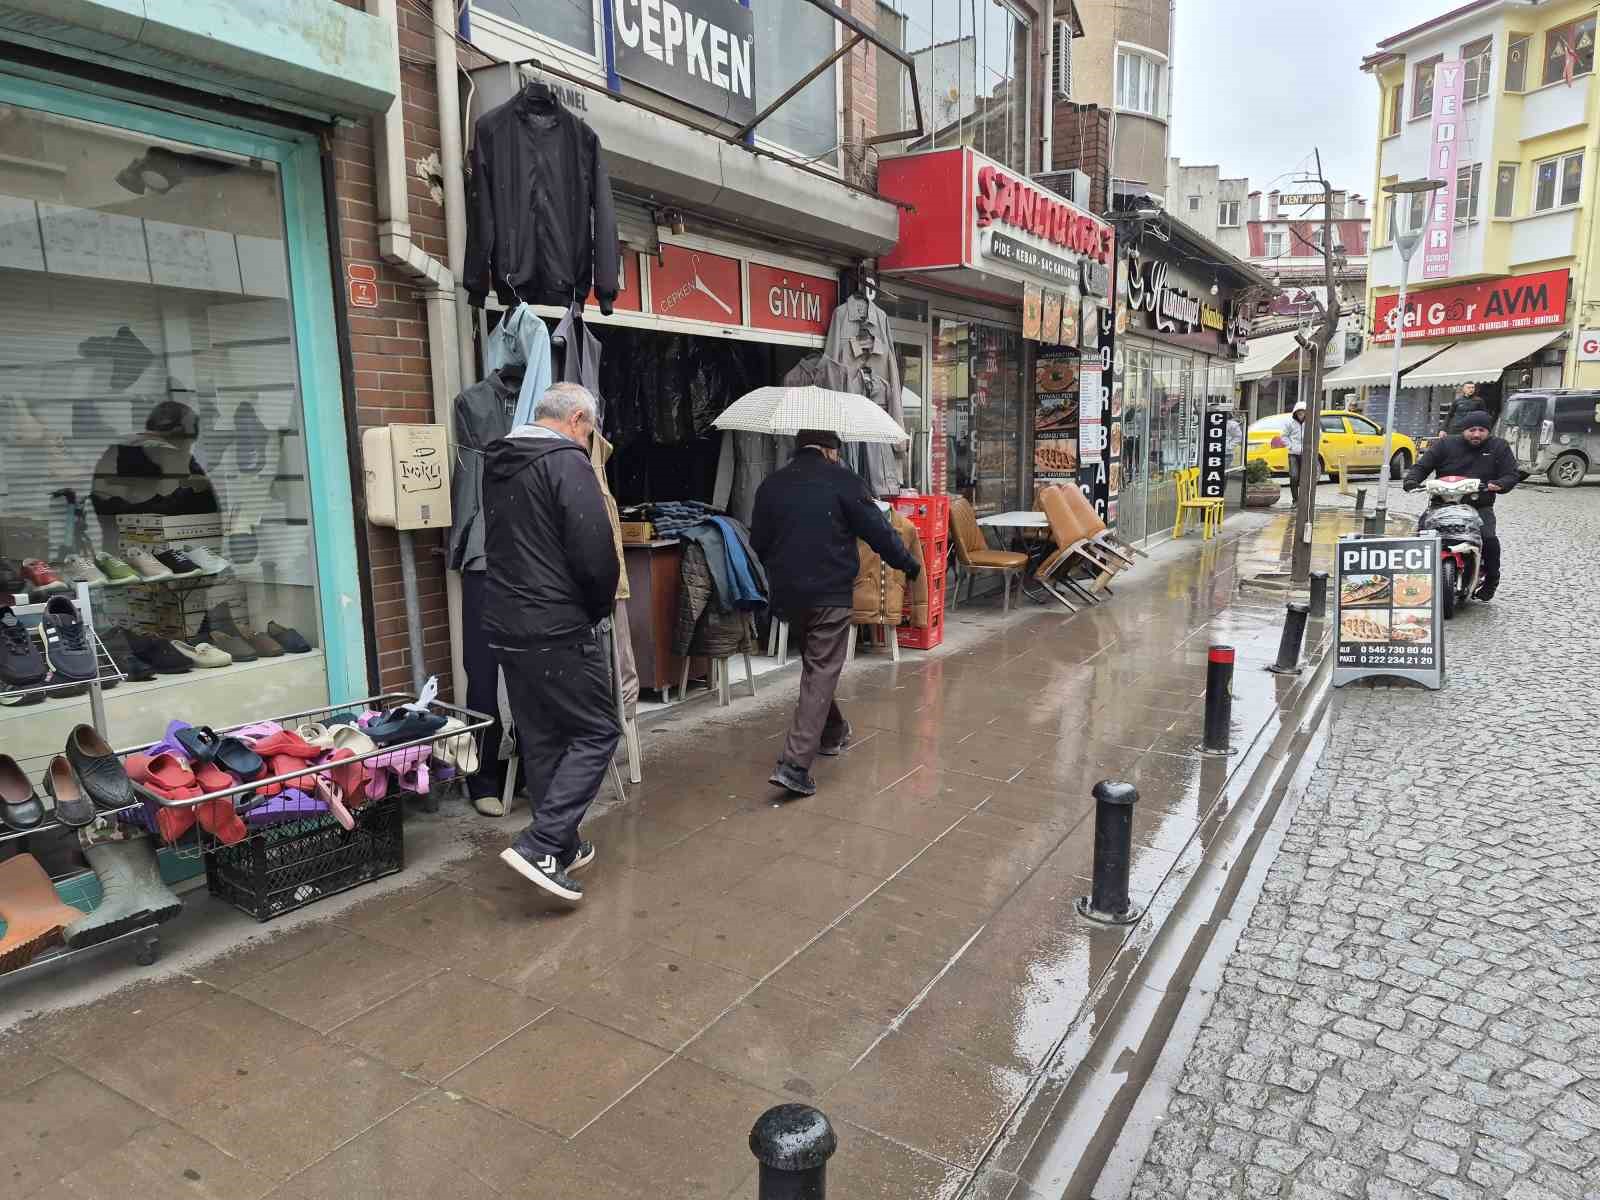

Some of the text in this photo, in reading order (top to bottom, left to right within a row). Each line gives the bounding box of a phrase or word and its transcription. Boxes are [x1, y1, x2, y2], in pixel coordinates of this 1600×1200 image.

[615, 0, 752, 99] CEPKEN
[1283, 195, 1303, 204] KENT
[994, 238, 1011, 257] PİDE
[1016, 248, 1037, 265] KEBAP
[768, 277, 821, 322] GİYİM
[1484, 283, 1549, 318] AVM
[1343, 545, 1432, 571] PİDECİ
[1339, 655, 1357, 663] PAKET
[1368, 656, 1386, 664] 222
[1387, 656, 1405, 664] 234
[1407, 656, 1418, 664] 21
[1420, 657, 1433, 665] 20
[1387, 646, 1404, 654] 730
[1421, 646, 1433, 654] 40
